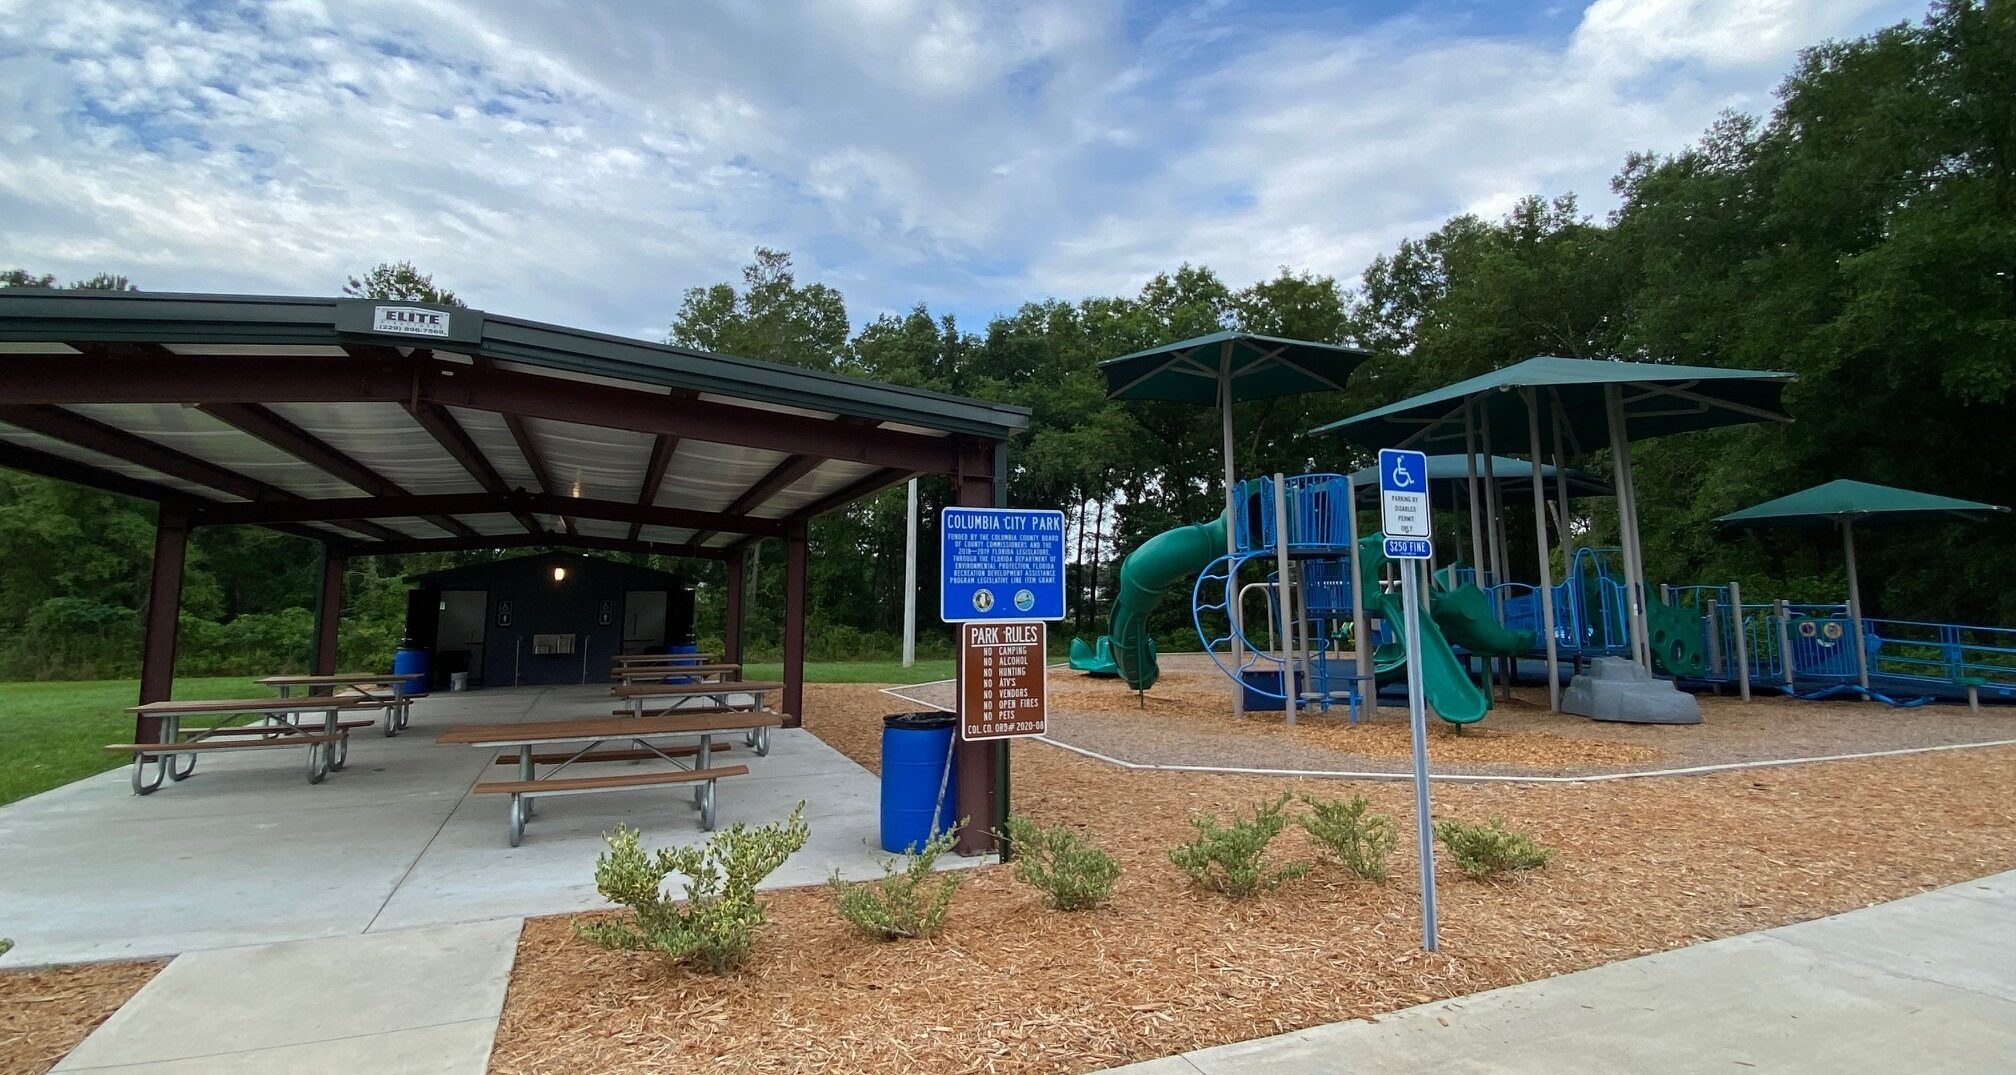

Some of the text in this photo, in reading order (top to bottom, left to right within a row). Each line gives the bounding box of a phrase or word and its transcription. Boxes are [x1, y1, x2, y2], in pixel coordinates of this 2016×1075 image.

[386, 311, 440, 325] ELITE
[1391, 495, 1411, 503] PARKING
[947, 514, 1060, 531] COLUMBIA CITY PARK
[947, 532, 968, 541] FUNDED
[970, 533, 977, 541] BY
[980, 533, 989, 541] THE
[1041, 534, 1058, 542] BOARD
[954, 540, 1052, 549] OF COUNTY COMMISSIONERS AND THE
[1389, 541, 1426, 553] $250 FINE
[1016, 548, 1051, 556] LEGISLATURE,
[1015, 555, 1048, 563] DEPARTMENT
[1049, 555, 1057, 563] OF
[954, 562, 996, 570] ENVIRONMENTAL
[1032, 562, 1055, 570] FLORIDA
[953, 569, 986, 577] RECREATION
[987, 569, 1023, 577] DEVELOPMENT
[949, 576, 975, 584] PROGRAM
[977, 576, 1009, 584] LEGISLATIVE
[971, 626, 1038, 645] PARK RULES
[983, 646, 1027, 656] NO CAMPING
[983, 656, 1028, 666] NO ALCOHOL
[983, 667, 1026, 677] NO HUNTING
[983, 678, 993, 688] NO
[983, 689, 1028, 698] NO VENDORS
[983, 698, 1039, 709] NO OPEN FIRES
[983, 711, 1015, 721] NO PETS
[1017, 721, 1044, 731] 2020-08
